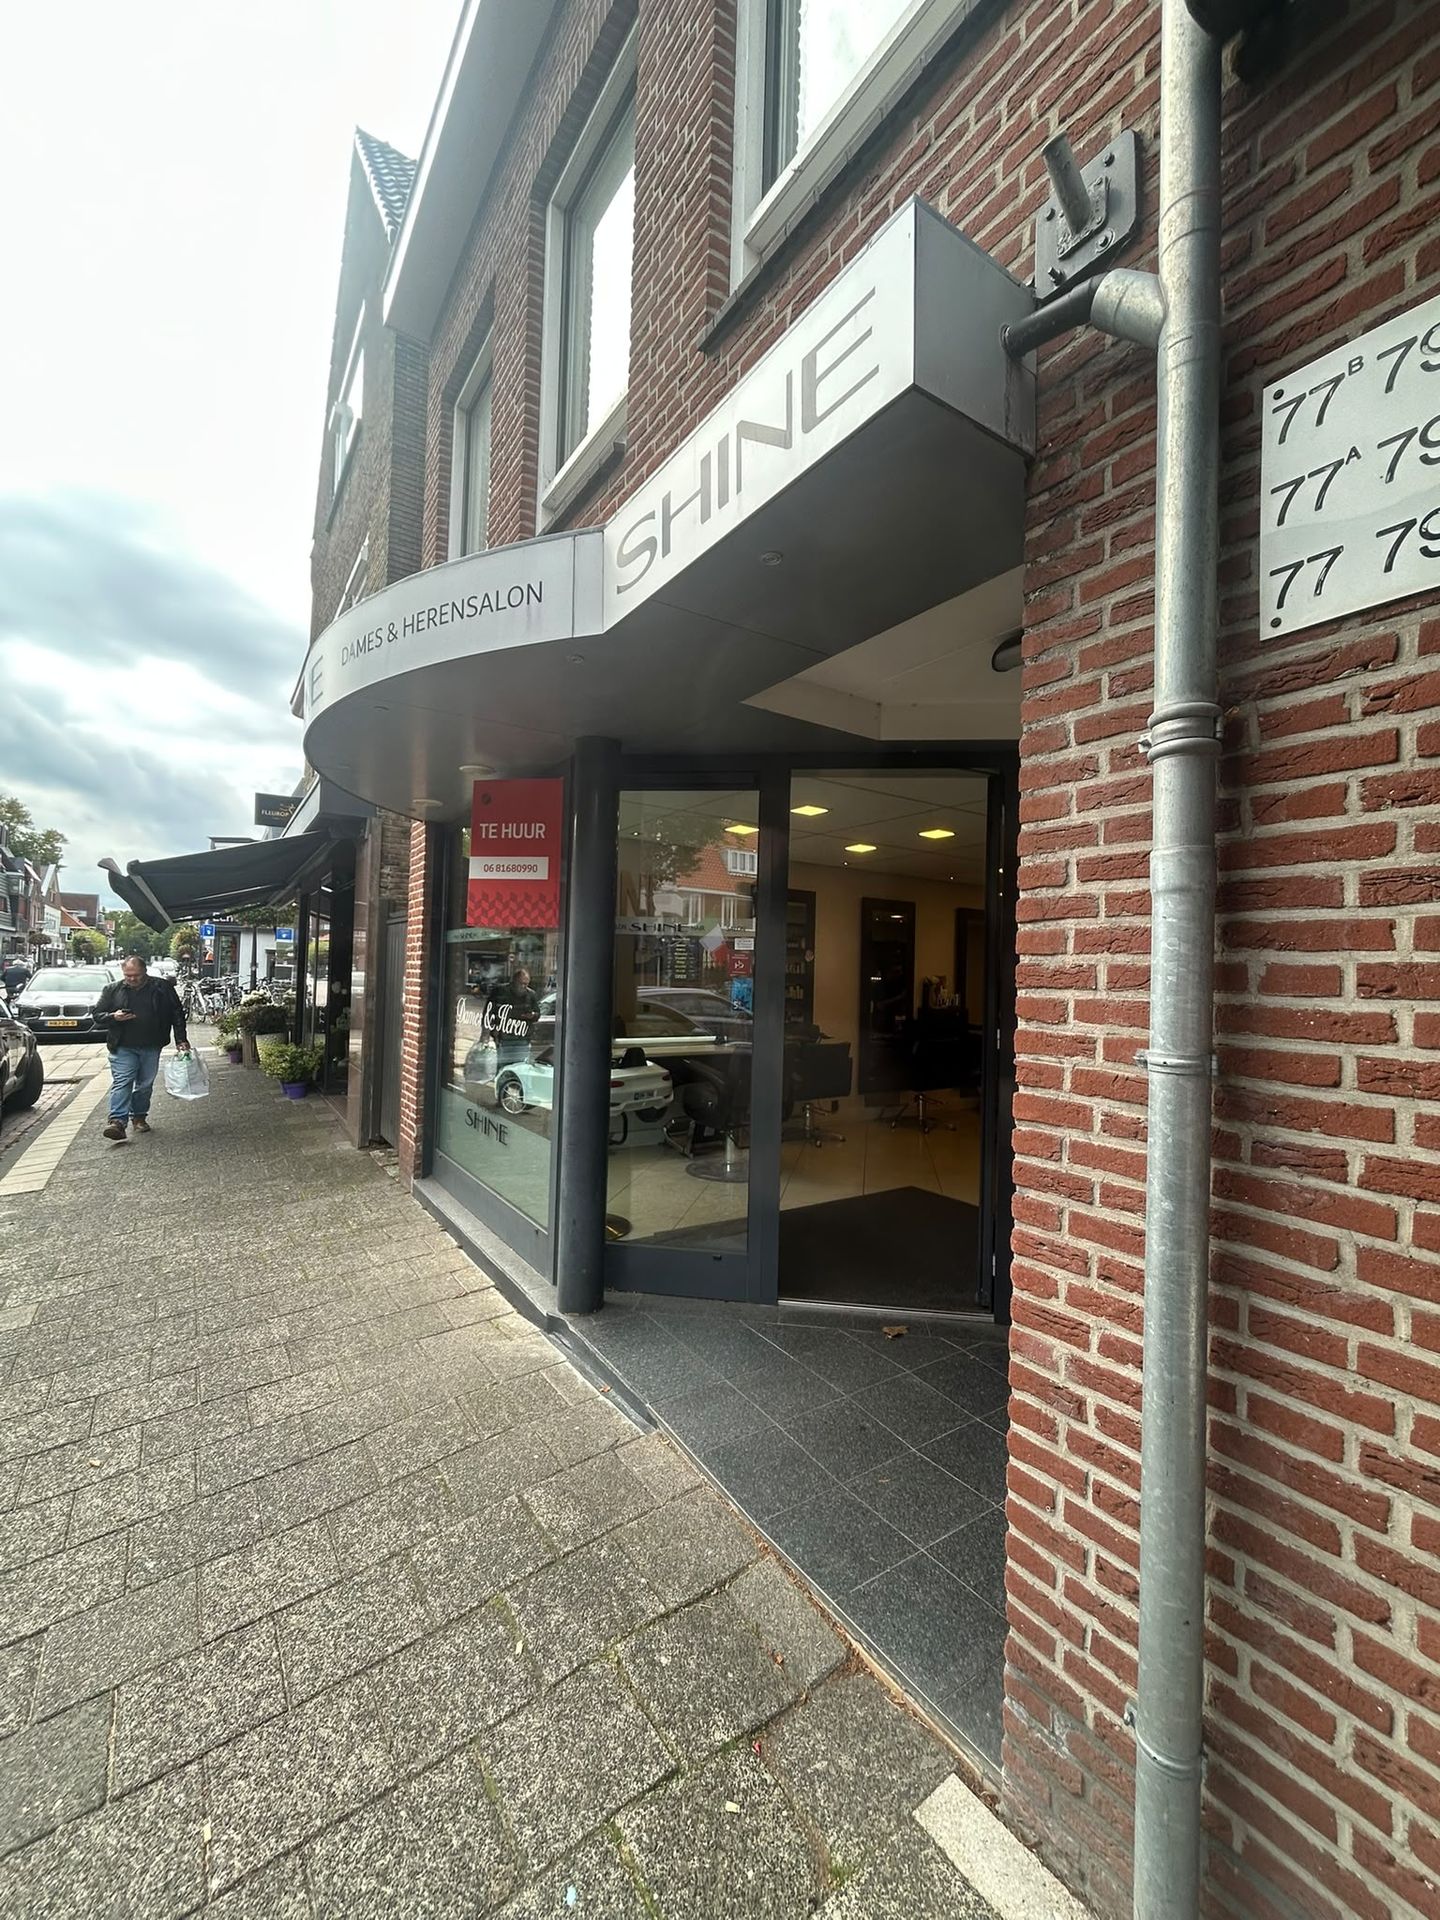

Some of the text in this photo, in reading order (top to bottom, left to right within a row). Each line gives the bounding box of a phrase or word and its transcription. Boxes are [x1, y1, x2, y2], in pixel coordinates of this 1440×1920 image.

[617, 286, 880, 595] SHINE
[1269, 545, 1344, 610] 77
[341, 581, 544, 666] DAMES & HERENSALON
[480, 823, 546, 839] TE HUUR
[484, 1001, 495, 1031] &
[496, 1004, 529, 1037] Heren
[465, 1108, 508, 1146] SHINE
